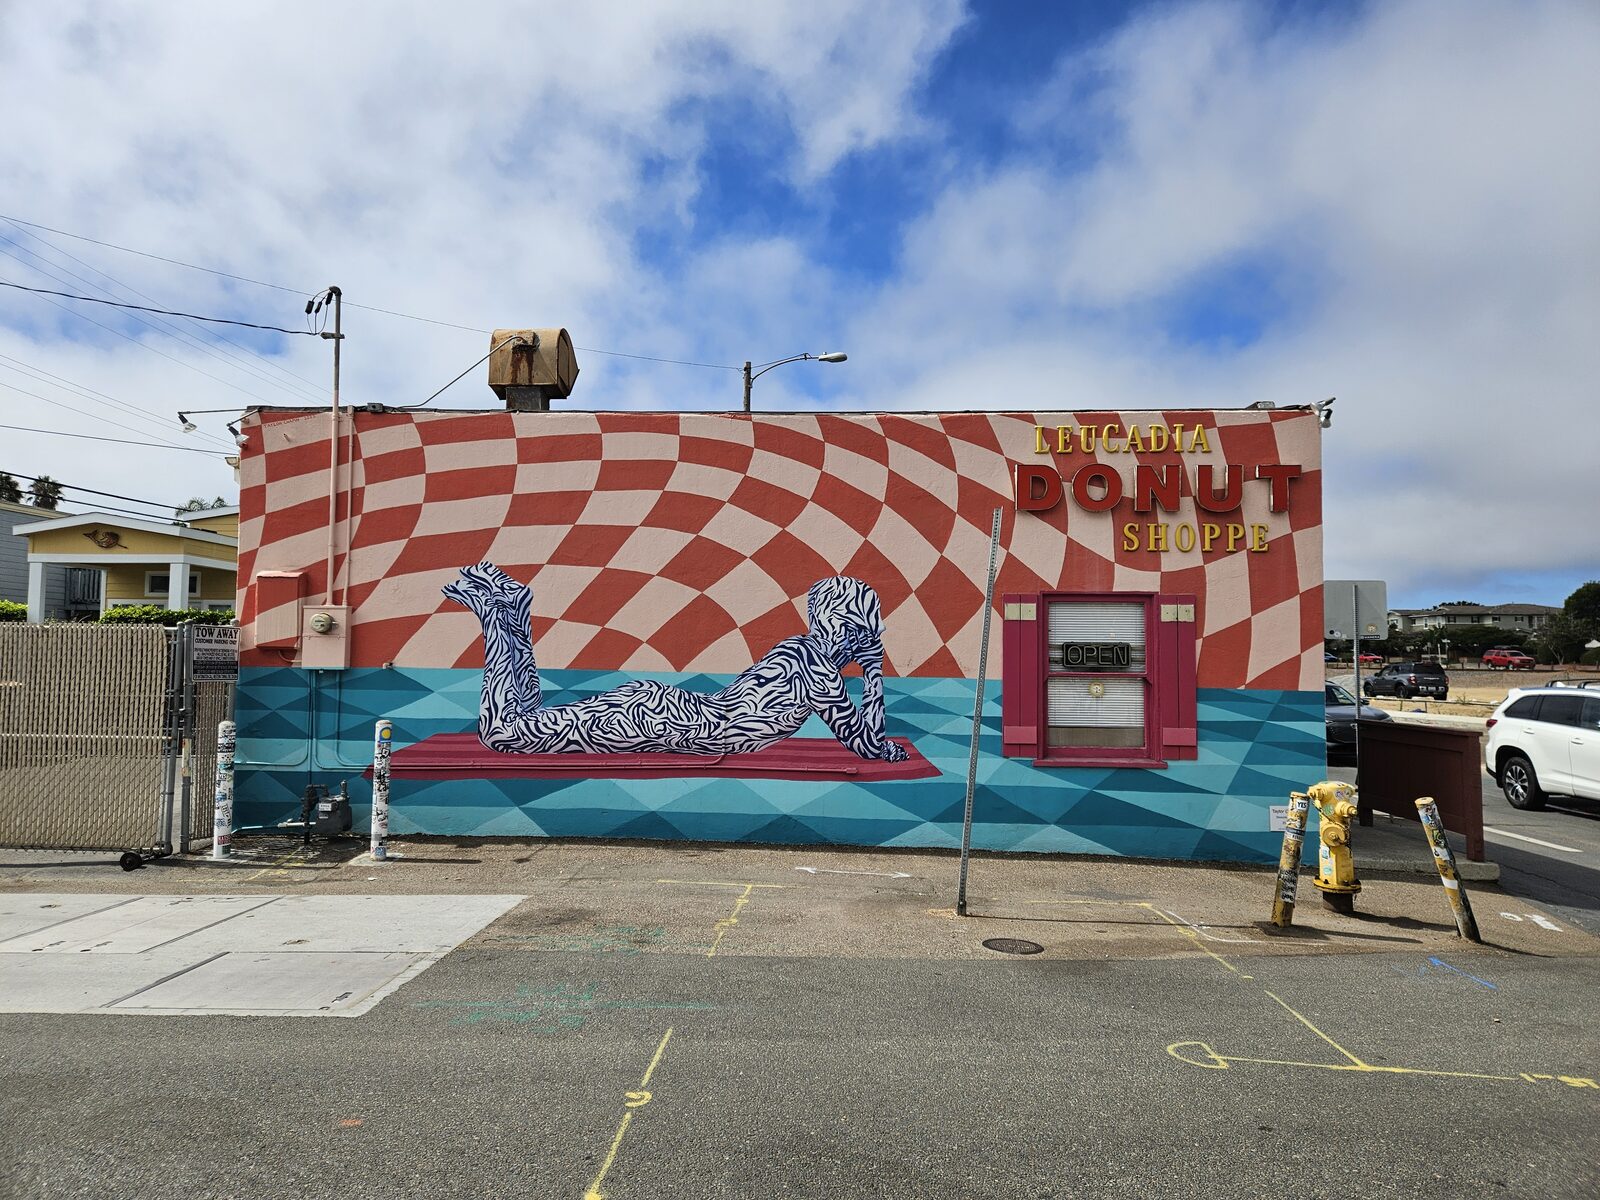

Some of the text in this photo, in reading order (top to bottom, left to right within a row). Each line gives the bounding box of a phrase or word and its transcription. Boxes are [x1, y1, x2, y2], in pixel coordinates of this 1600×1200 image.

[1034, 424, 1212, 453] LEUCADIA
[1014, 464, 1302, 512] DONUT
[1123, 522, 1270, 552] SHOPPE
[195, 627, 239, 639] TOW AWAY
[1067, 645, 1127, 665] OPEN
[1297, 801, 1308, 809] YES
